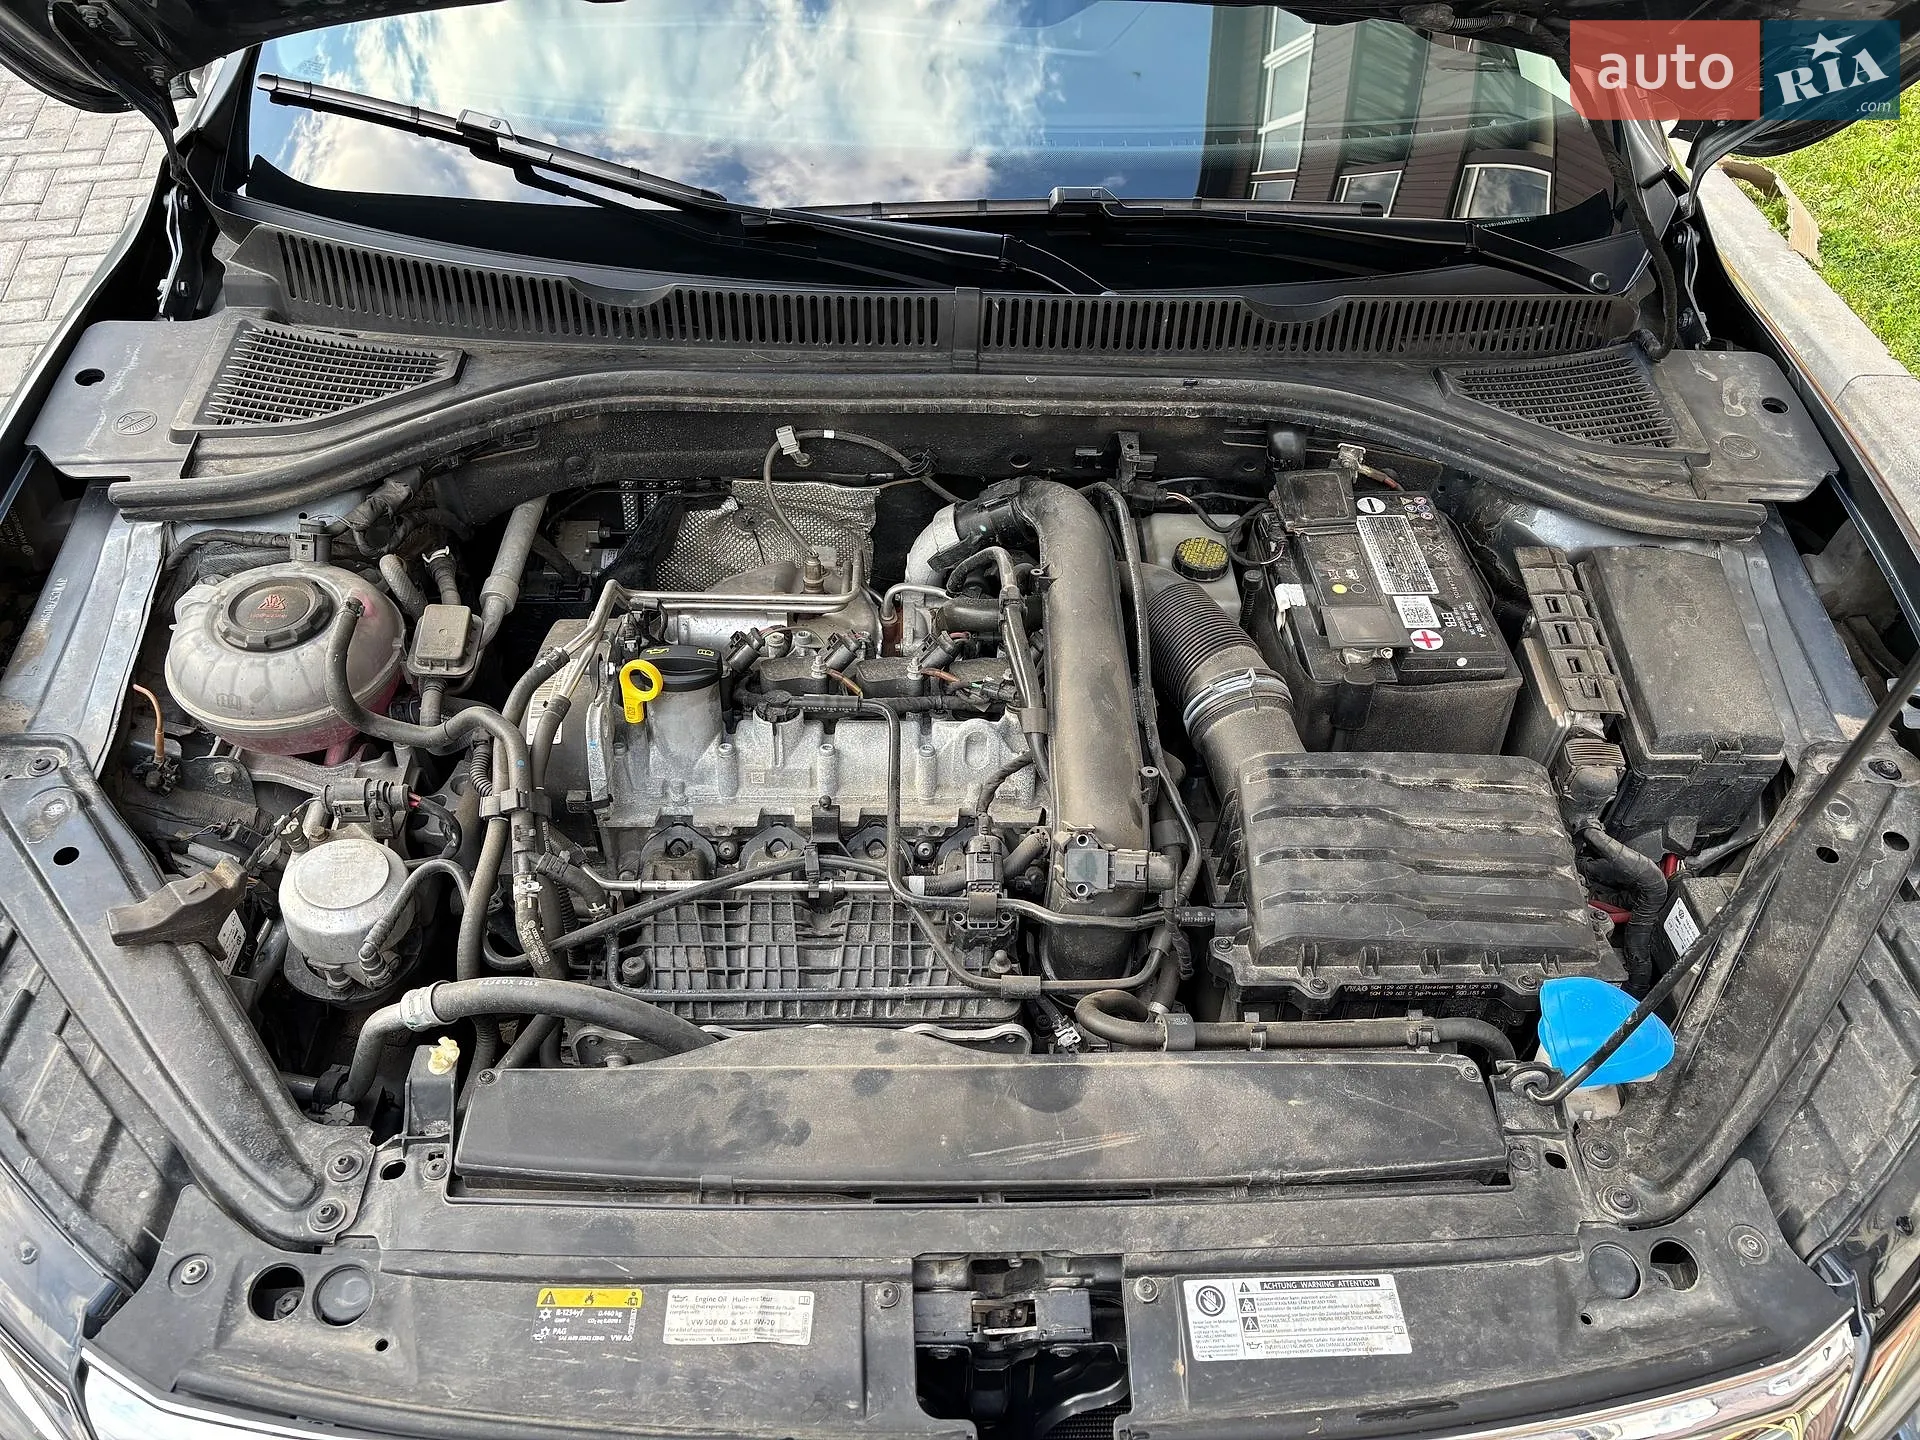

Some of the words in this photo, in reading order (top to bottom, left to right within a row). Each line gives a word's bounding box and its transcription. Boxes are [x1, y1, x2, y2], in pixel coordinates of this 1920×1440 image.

[1441, 612, 1458, 628] EFB
[1263, 1282, 1297, 1290] ACHTUNG
[695, 1295, 717, 1304] Engine
[717, 1295, 728, 1303] Oil
[553, 1327, 567, 1335] PAG
